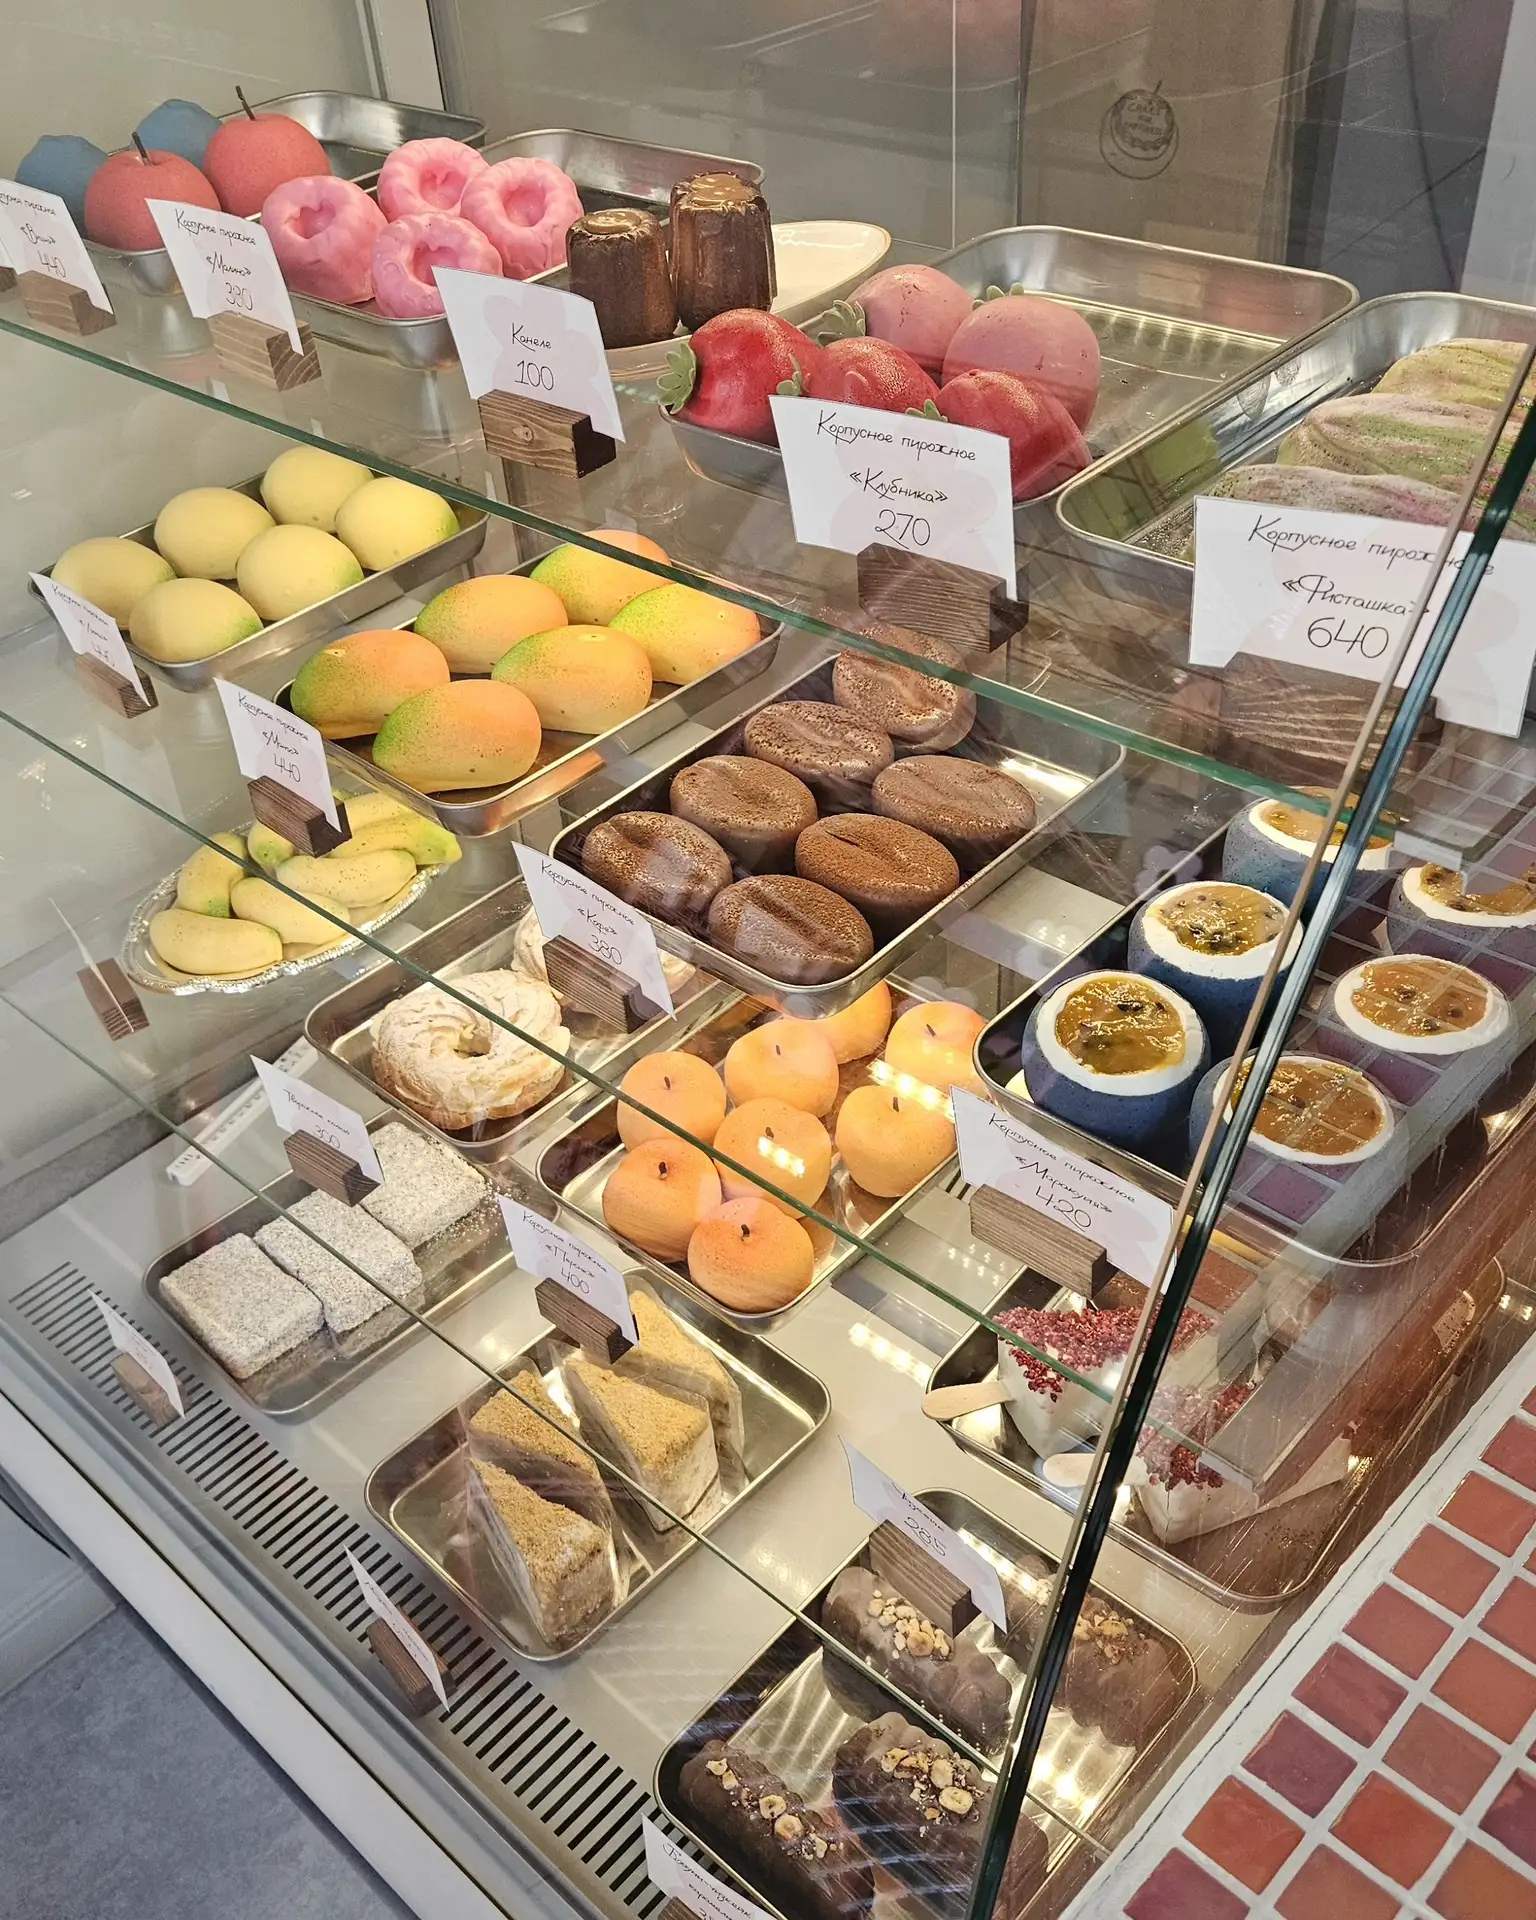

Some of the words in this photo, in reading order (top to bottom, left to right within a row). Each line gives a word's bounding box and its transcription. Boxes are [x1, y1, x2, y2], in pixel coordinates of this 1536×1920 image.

[175, 208, 216, 236] Корпусное
[219, 228, 256, 246] пирожное
[511, 322, 552, 352] Канеле
[514, 360, 555, 391] 100
[816, 409, 893, 444] Корпусное
[901, 436, 976, 461] пирожное
[849, 467, 949, 502] «Клубника»
[874, 508, 931, 550] 270
[1248, 514, 1357, 552] Корпусное
[1307, 616, 1390, 659] 640
[273, 752, 301, 783] 440
[541, 859, 588, 895] Корпусное
[591, 893, 635, 926] пирожное
[587, 934, 623, 966] 380
[988, 1112, 1057, 1161] Корпусное
[1064, 1161, 1136, 1203] пирожное
[1034, 1185, 1093, 1233] 420
[560, 1266, 590, 1295] 400
[903, 1516, 948, 1557] 285
